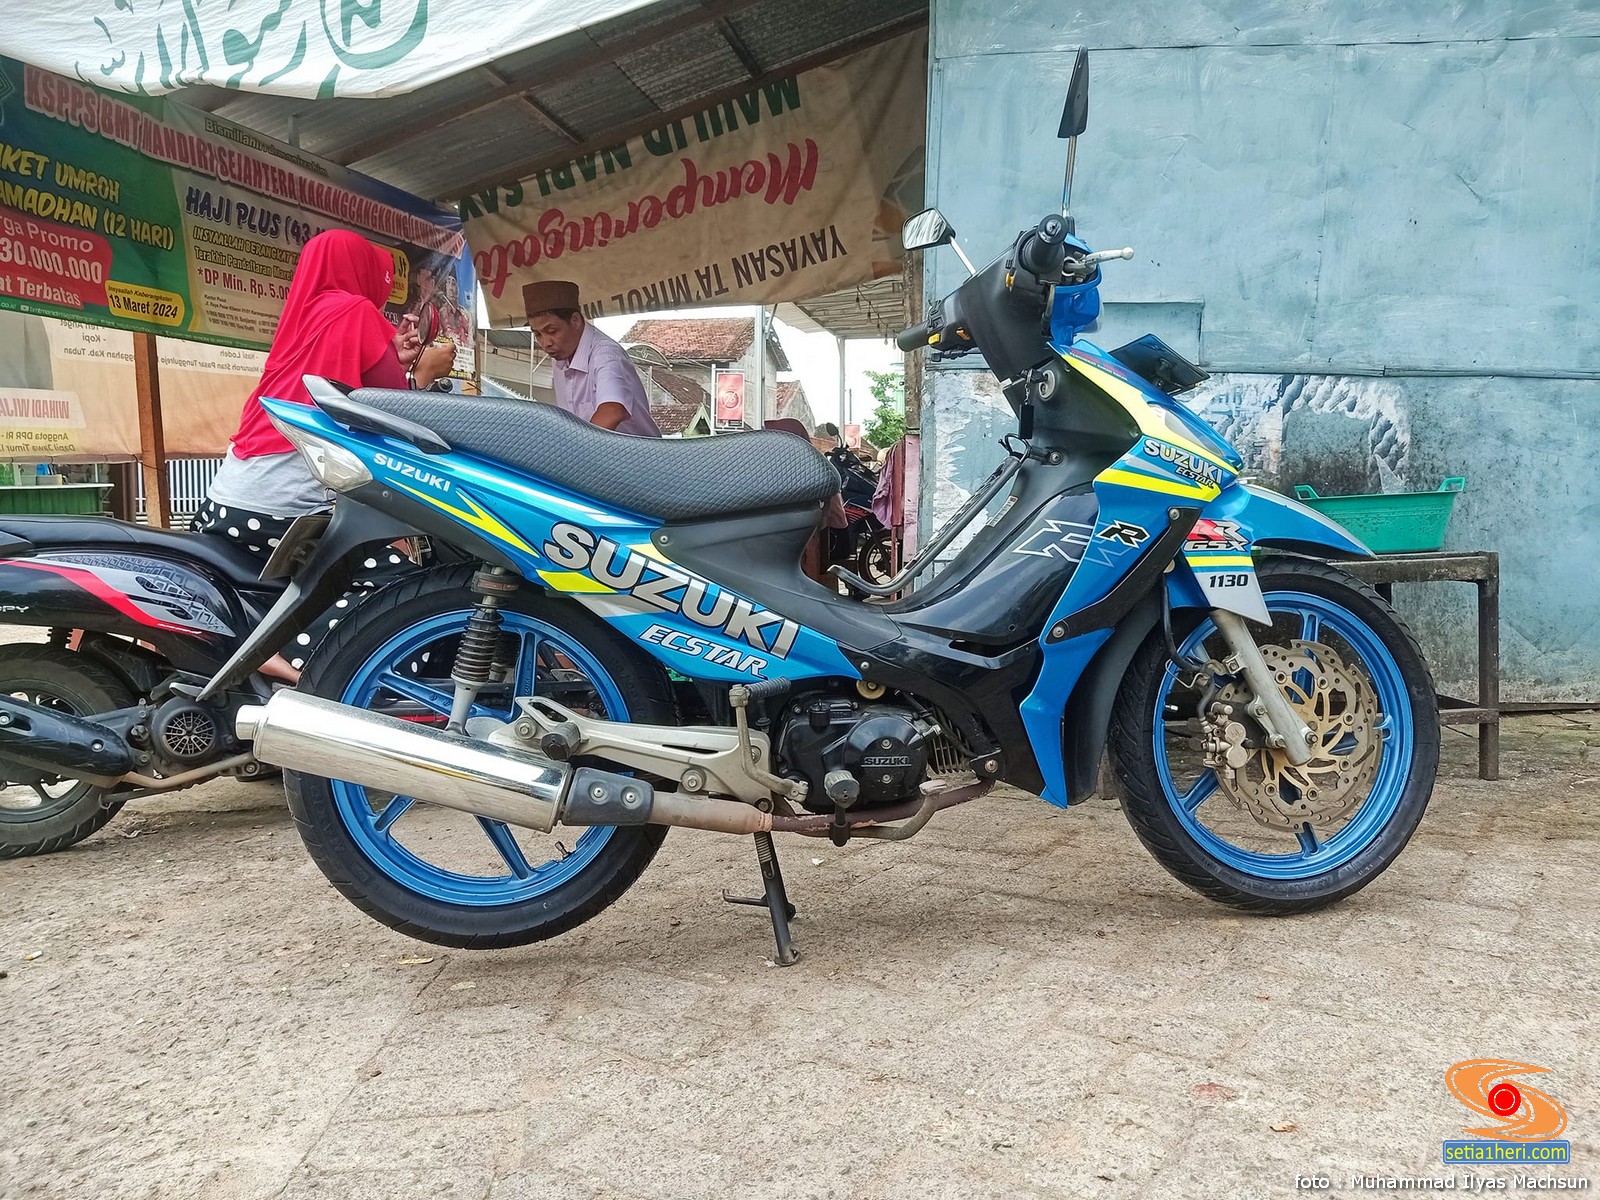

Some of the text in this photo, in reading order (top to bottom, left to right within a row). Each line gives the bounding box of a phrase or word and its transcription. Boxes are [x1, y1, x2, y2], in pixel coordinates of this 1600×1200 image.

[26, 66, 98, 130] KSPPS
[101, 98, 141, 147] BMT
[142, 117, 216, 174] MANDIRI
[217, 145, 298, 201] SEJAHTERA
[55, 161, 120, 204] UMROH
[103, 208, 126, 238] (12
[130, 217, 175, 250] HARI)
[186, 186, 232, 225] HAJI
[237, 202, 281, 239] PLUS
[474, 137, 819, 299] Memperingati
[26, 221, 94, 253] Promo
[193, 226, 245, 252] INSYAALLAH
[731, 225, 848, 289] YAYASAN
[194, 246, 227, 266] Terakhir
[227, 254, 273, 277] Pendaftaran
[17, 277, 82, 306] Terbatas
[223, 272, 247, 292] Min.
[250, 279, 267, 298] Rp.
[109, 294, 178, 318] 13 Maret 2024
[373, 452, 451, 493] SUZUKI
[1143, 438, 1224, 485] SUZUKI
[1175, 466, 1215, 490] ECSTAR
[543, 520, 800, 660] SUZUKI
[1209, 573, 1249, 588] 1130
[637, 623, 770, 680] ECSTAR
[862, 755, 912, 766] SUZUKI
